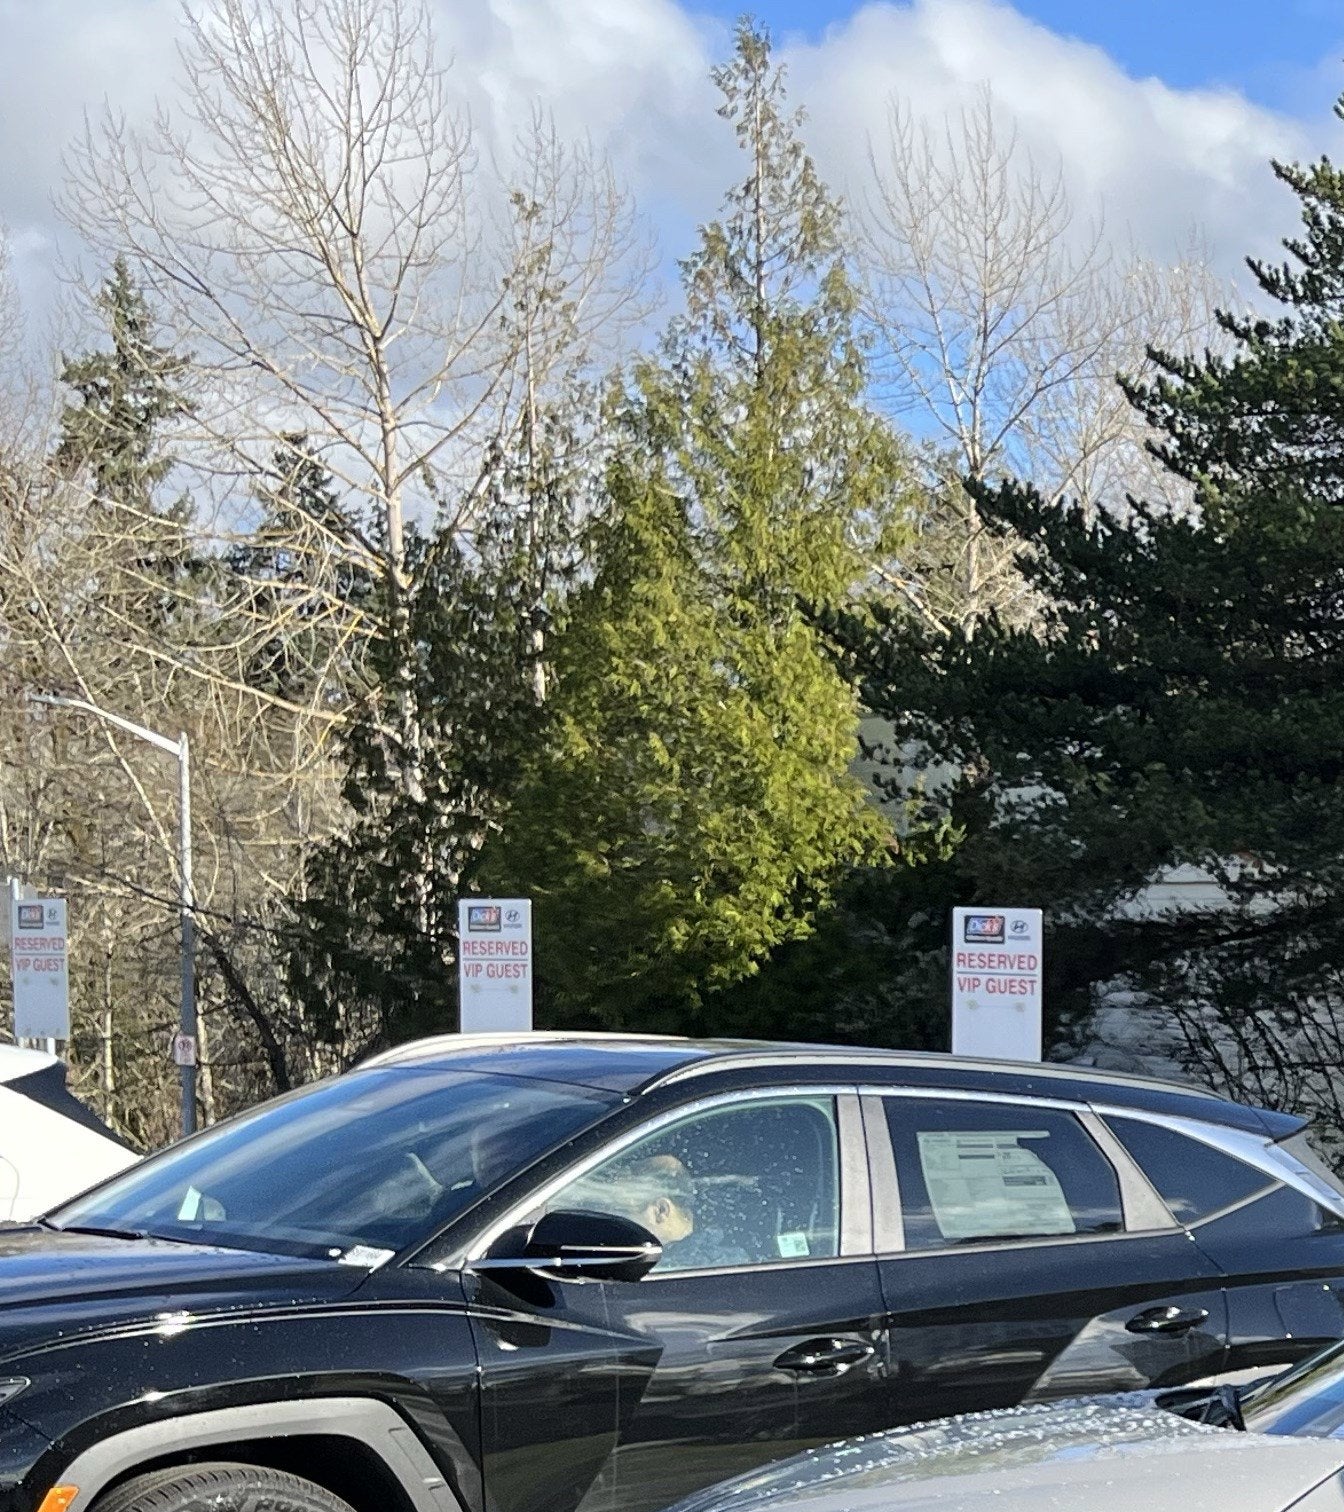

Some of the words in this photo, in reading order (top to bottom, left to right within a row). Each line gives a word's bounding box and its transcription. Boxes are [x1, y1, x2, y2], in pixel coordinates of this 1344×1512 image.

[462, 941, 529, 956] RESERVED
[463, 962, 483, 978] VIP
[486, 963, 528, 979] GUEST
[956, 952, 1038, 971] RESERVED
[957, 976, 981, 993] VIP
[986, 978, 1038, 996] GUEST
